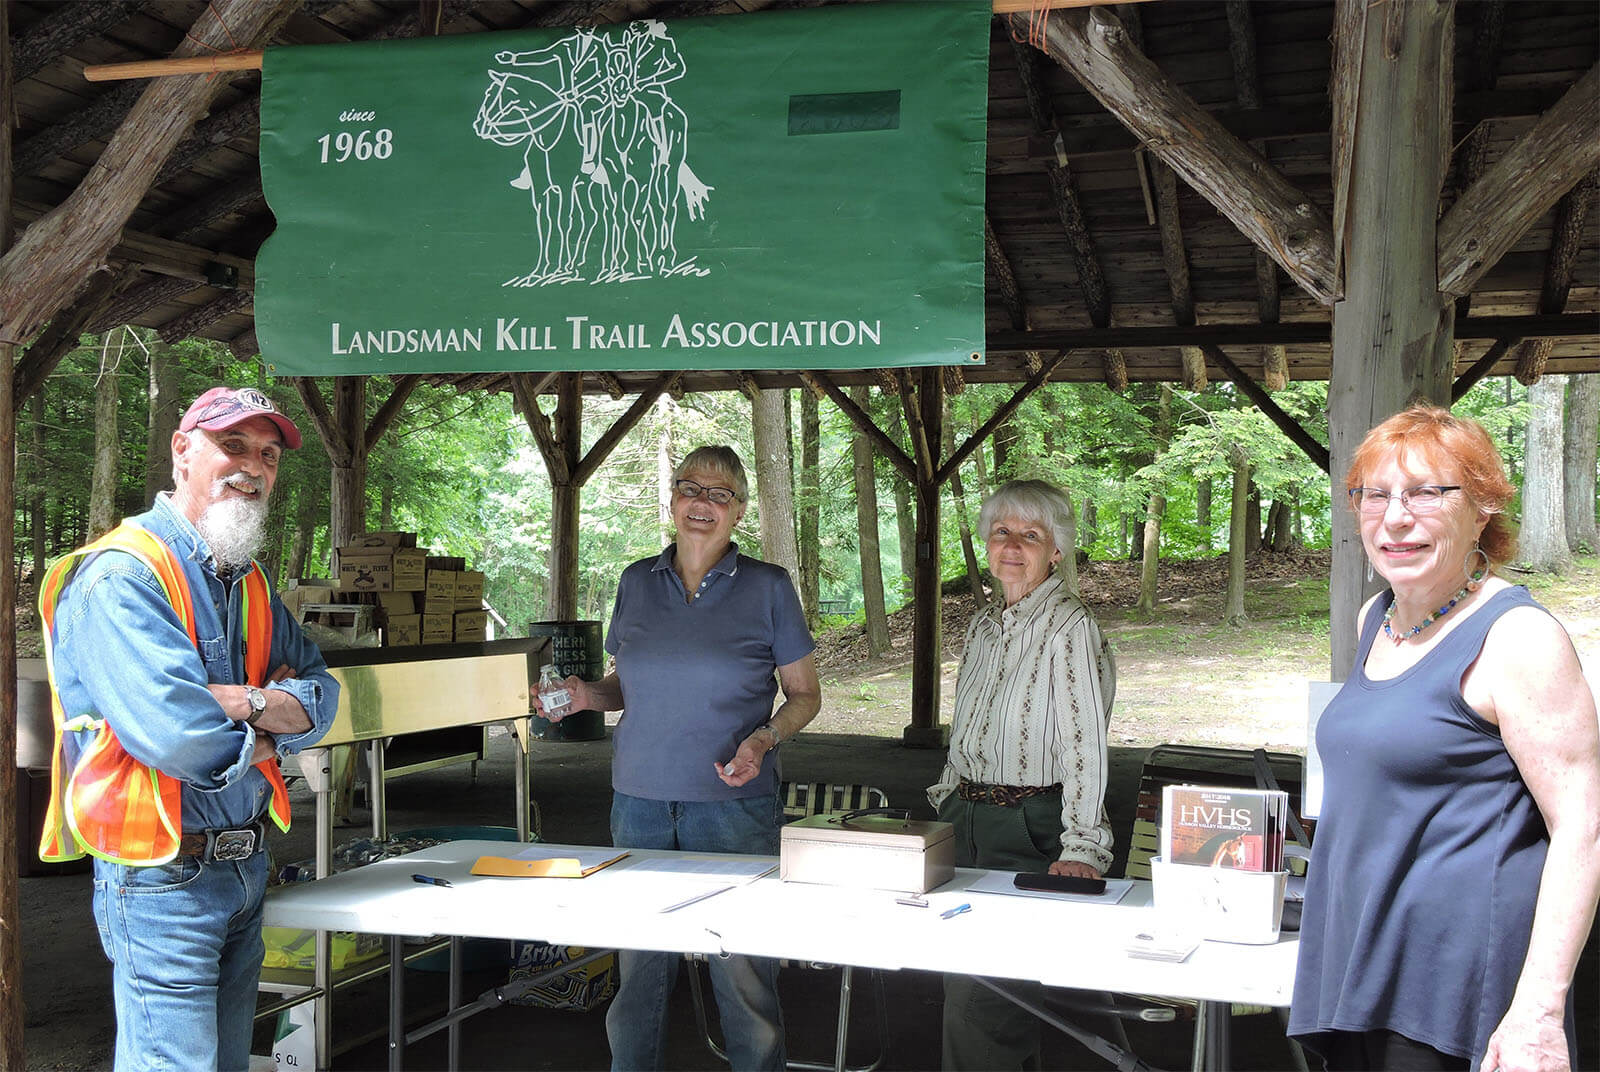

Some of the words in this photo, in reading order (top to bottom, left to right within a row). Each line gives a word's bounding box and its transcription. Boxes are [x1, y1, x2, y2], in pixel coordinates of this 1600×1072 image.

[339, 109, 375, 122] since
[318, 129, 392, 163] 1968
[333, 323, 481, 354] LANDSMAN
[497, 318, 556, 350] KILL
[566, 316, 651, 349] TRAIL
[662, 314, 880, 347] ASSOCIATION
[563, 664, 586, 676] GUN
[1181, 805, 1252, 827] HVHS
